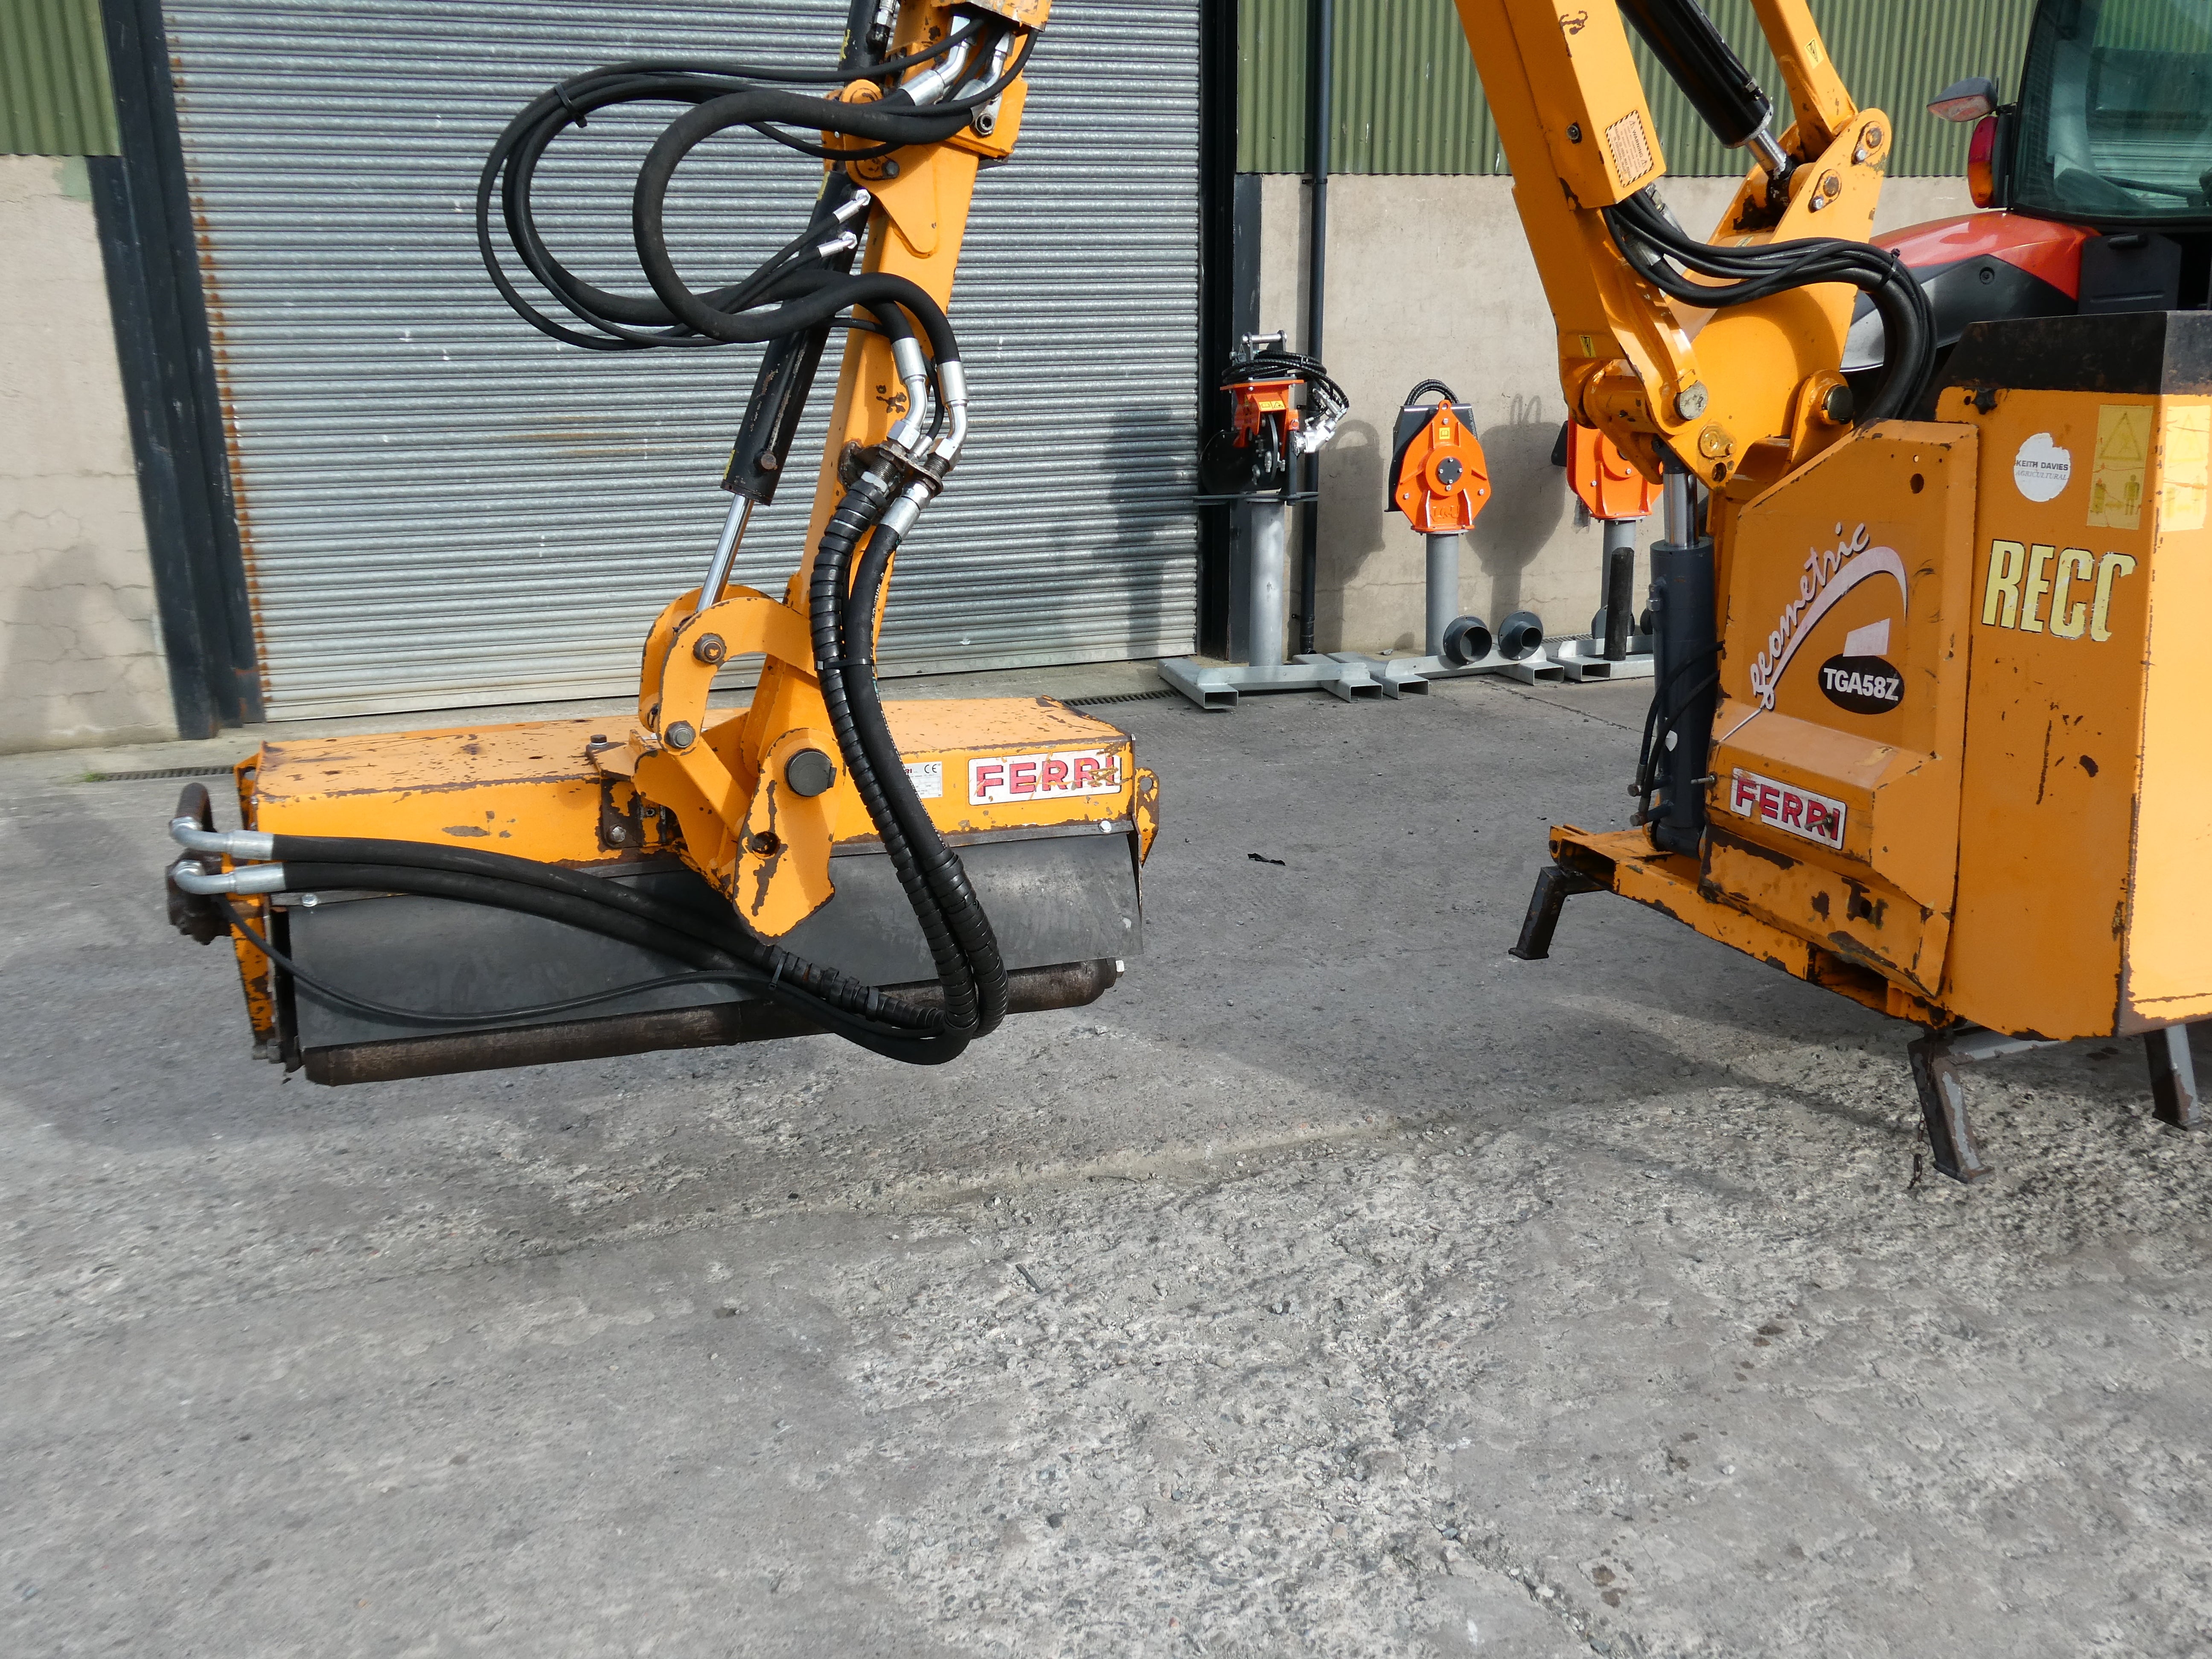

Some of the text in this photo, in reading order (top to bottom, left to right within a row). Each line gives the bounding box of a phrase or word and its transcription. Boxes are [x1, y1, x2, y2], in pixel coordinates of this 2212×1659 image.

[1632, 129, 1643, 158] WARNING
[2015, 470, 2067, 480] AGRICULTURAL
[2041, 462, 2068, 471] DAVIES
[1823, 668, 1899, 701] TGA58Z
[924, 764, 937, 773] CE
[976, 757, 1115, 797] FERRI
[1736, 777, 1840, 841] FERRI
